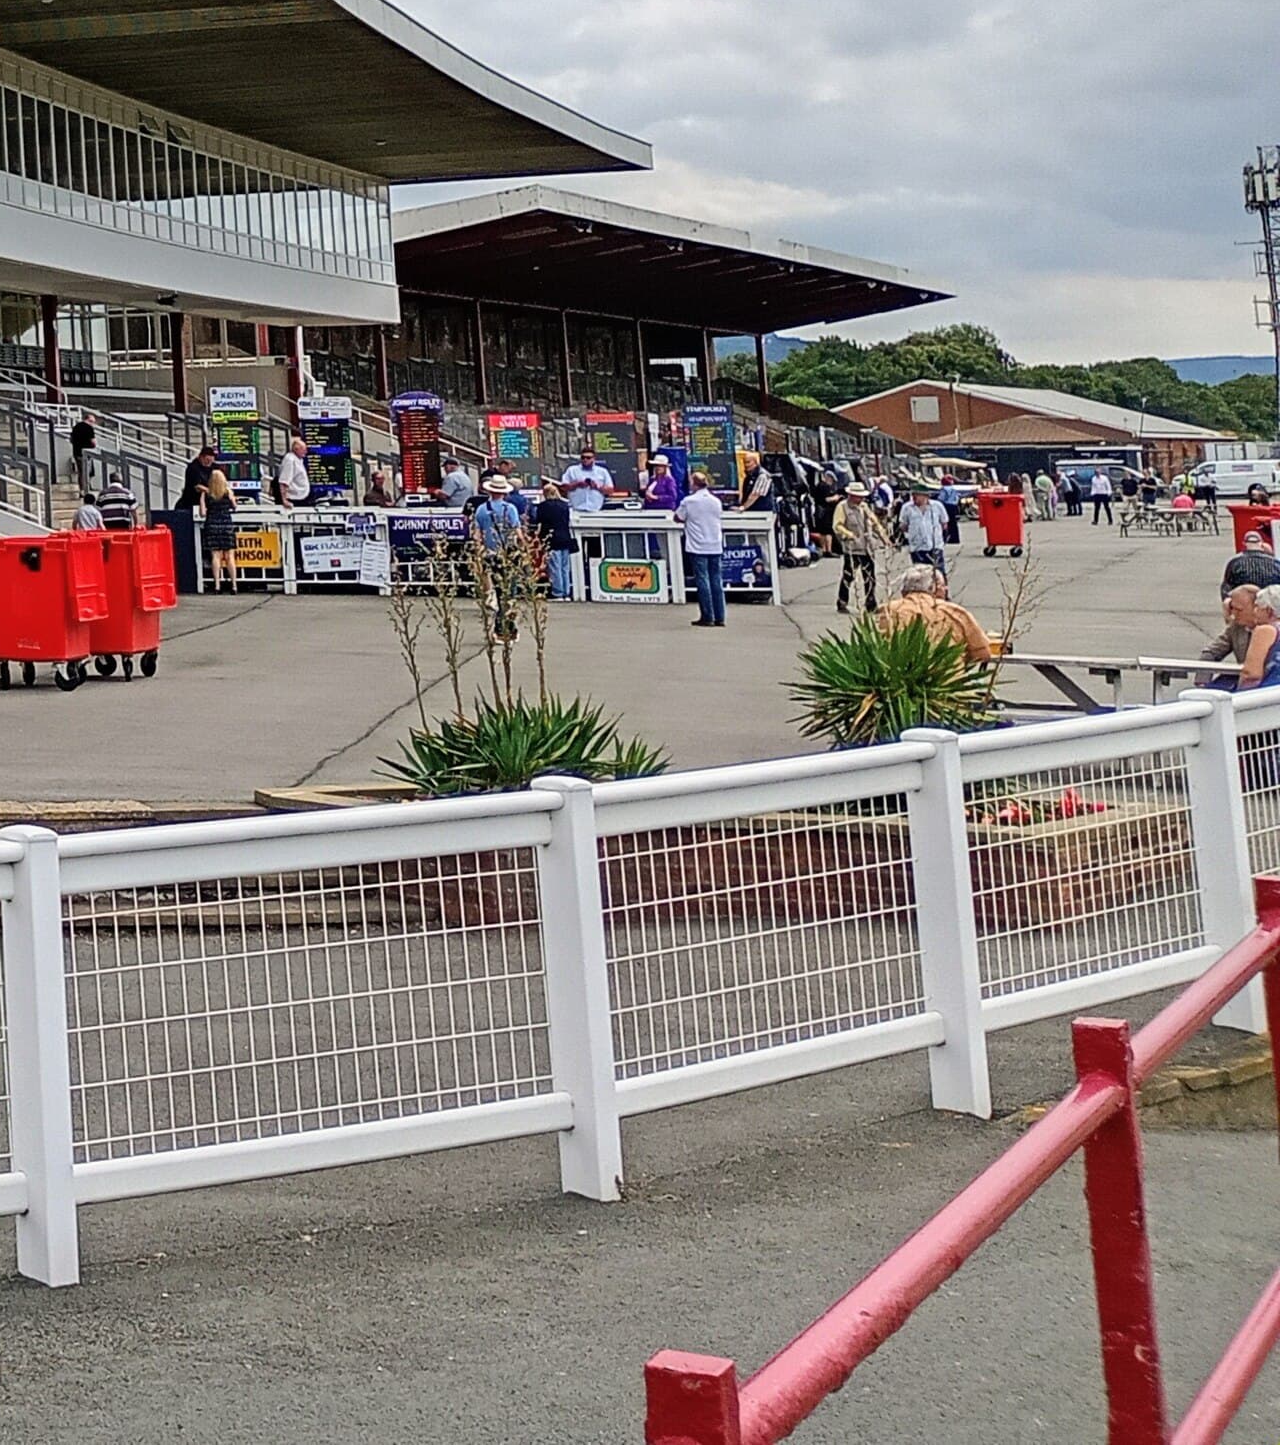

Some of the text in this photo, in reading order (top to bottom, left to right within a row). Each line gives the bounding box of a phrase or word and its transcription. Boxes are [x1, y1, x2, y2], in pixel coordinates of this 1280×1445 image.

[213, 400, 254, 408] JOHNSON
[392, 519, 464, 530] JOHNNY RIDLEY
[234, 537, 263, 548] EITH
[234, 550, 272, 561] HNSON
